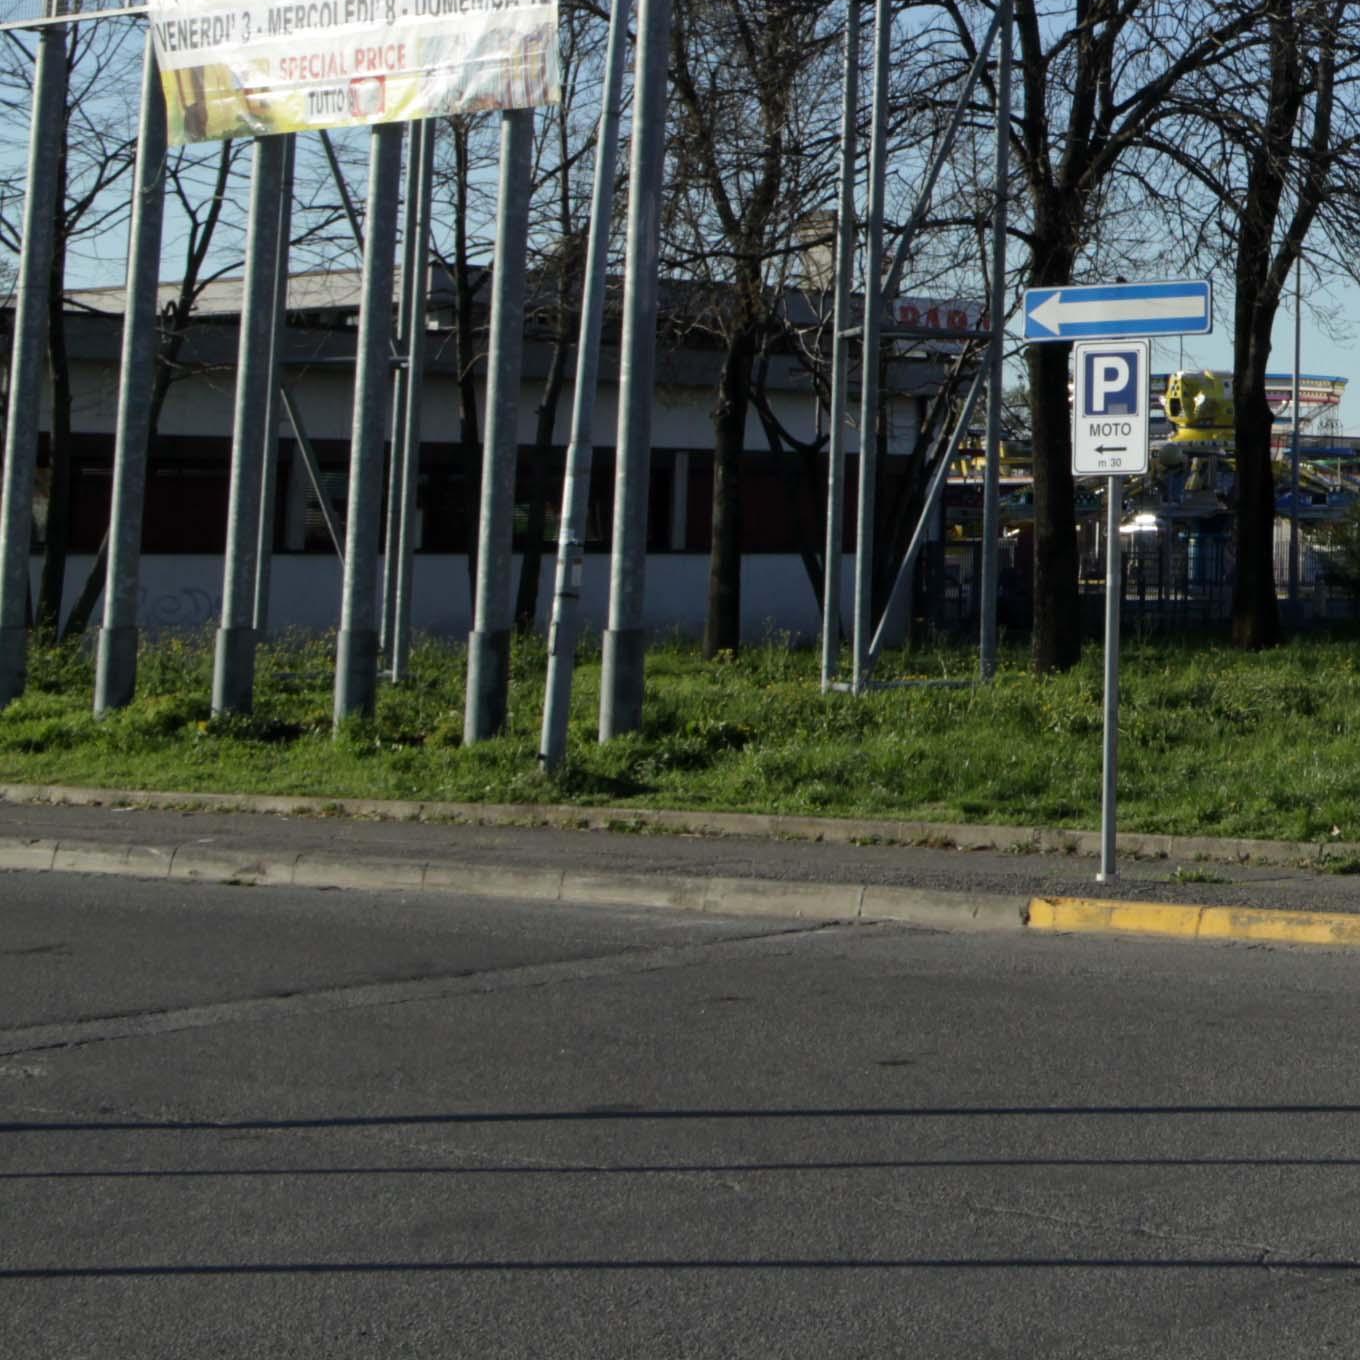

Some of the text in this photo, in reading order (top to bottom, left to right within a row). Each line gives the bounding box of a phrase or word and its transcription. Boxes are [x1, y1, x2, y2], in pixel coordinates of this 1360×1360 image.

[155, 13, 235, 53] VENERDI'
[280, 43, 406, 80] SPECIAL PRICE
[1092, 356, 1129, 411] P
[1089, 422, 1132, 437] MOTO
[1098, 458, 1122, 468] m 30
